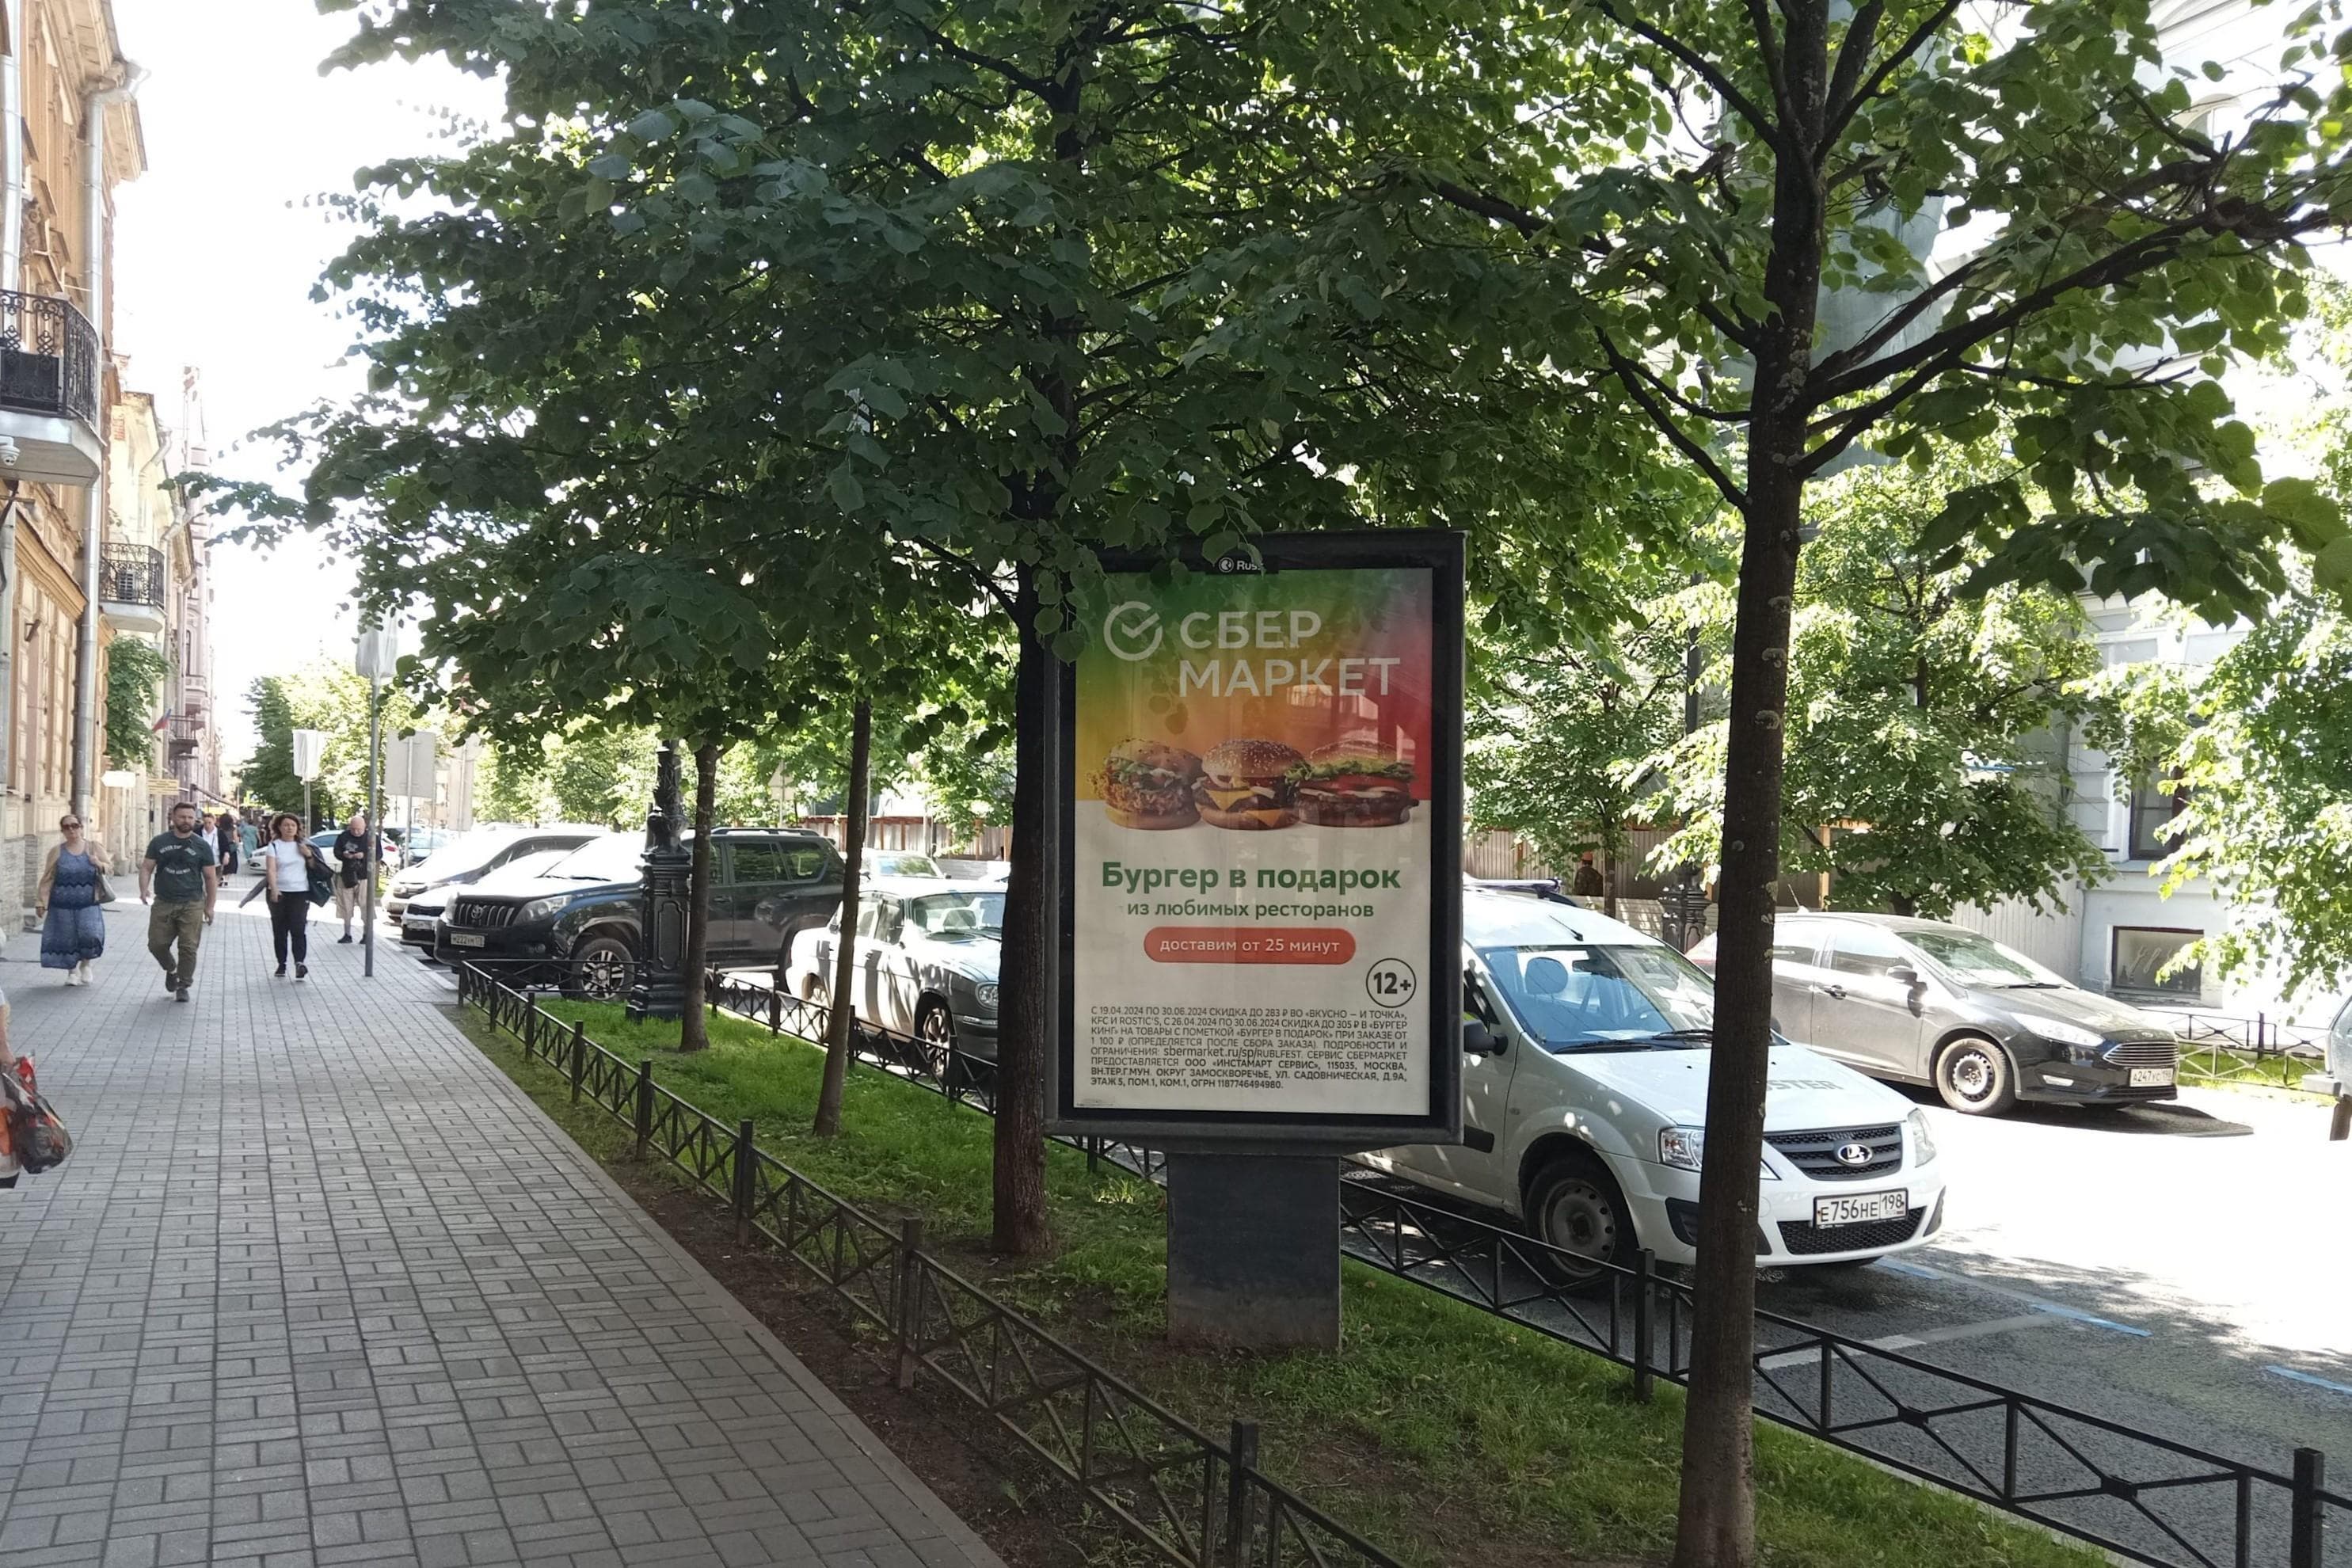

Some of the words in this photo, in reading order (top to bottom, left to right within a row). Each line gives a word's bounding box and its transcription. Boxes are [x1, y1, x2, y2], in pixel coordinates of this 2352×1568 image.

[1180, 610, 1322, 649] СБЕР
[1179, 657, 1400, 698] МАРКЕТ
[1102, 862, 1218, 894] Бургер
[1229, 869, 1246, 888] в
[1257, 870, 1401, 895] подарок
[1128, 903, 1149, 915] из
[1155, 899, 1249, 916] любимых
[1255, 904, 1374, 920] ресторанов
[1160, 940, 1236, 952] доставим
[1242, 942, 1260, 951] от
[1265, 938, 1284, 951] 25
[1289, 942, 1340, 954] минут
[1373, 972, 1412, 995] 12+
[1100, 1007, 1144, 1015] 19.04.2024
[1146, 1007, 1159, 1015] ПО
[1162, 1007, 1207, 1016] 30.06.2024
[1209, 1008, 1246, 1017] СКИДКА
[1290, 1009, 1303, 1018] ВО
[1171, 1018, 1216, 1026] 26.04.2024
[1235, 1018, 1280, 1027] 30.06.2024
[1281, 1019, 1319, 1028] СКИДКА
[1322, 1020, 1334, 1029] ДО
[1136, 1027, 1172, 1036] ТОВАРЫ
[1183, 1027, 1234, 1037] ПОМЕТКОЙ
[1357, 1031, 1392, 1040] ЗАКАЗЕ
[1243, 1039, 1273, 1048] СБОРА
[1323, 1041, 1395, 1049] ПОДРОБНОСТИ
[1091, 1057, 1179, 1067] ПРЕДОСТАВЛЯЕТСЯ
[1347, 1051, 1407, 1060] СБЕРМАРКЕТ
[1191, 1079, 1215, 1087] ОГРН
[1882, 1193, 1903, 1210] 198
